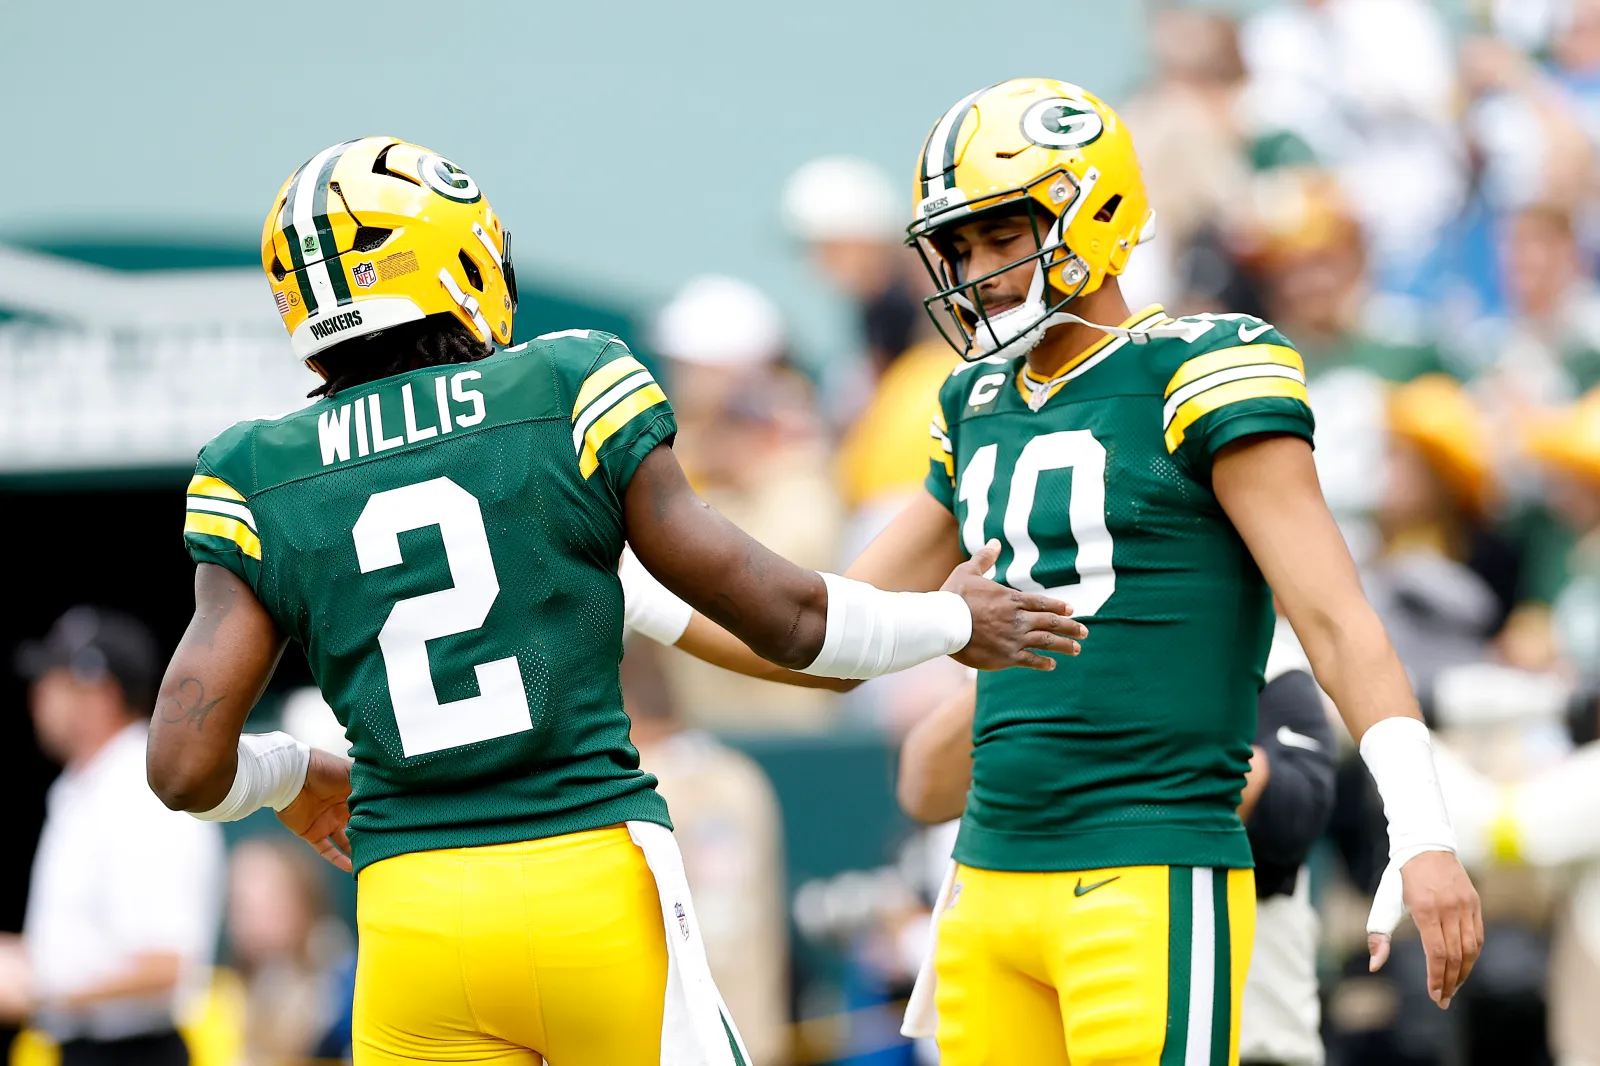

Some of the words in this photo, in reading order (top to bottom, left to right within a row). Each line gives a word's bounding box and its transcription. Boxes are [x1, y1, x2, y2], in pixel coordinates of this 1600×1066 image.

[1022, 97, 1104, 147] G
[420, 154, 480, 201] G
[310, 310, 363, 340] PACKERS
[968, 372, 1006, 407] C
[317, 369, 487, 466] WILLIS
[958, 428, 1117, 617] 10
[351, 475, 534, 759] 2
